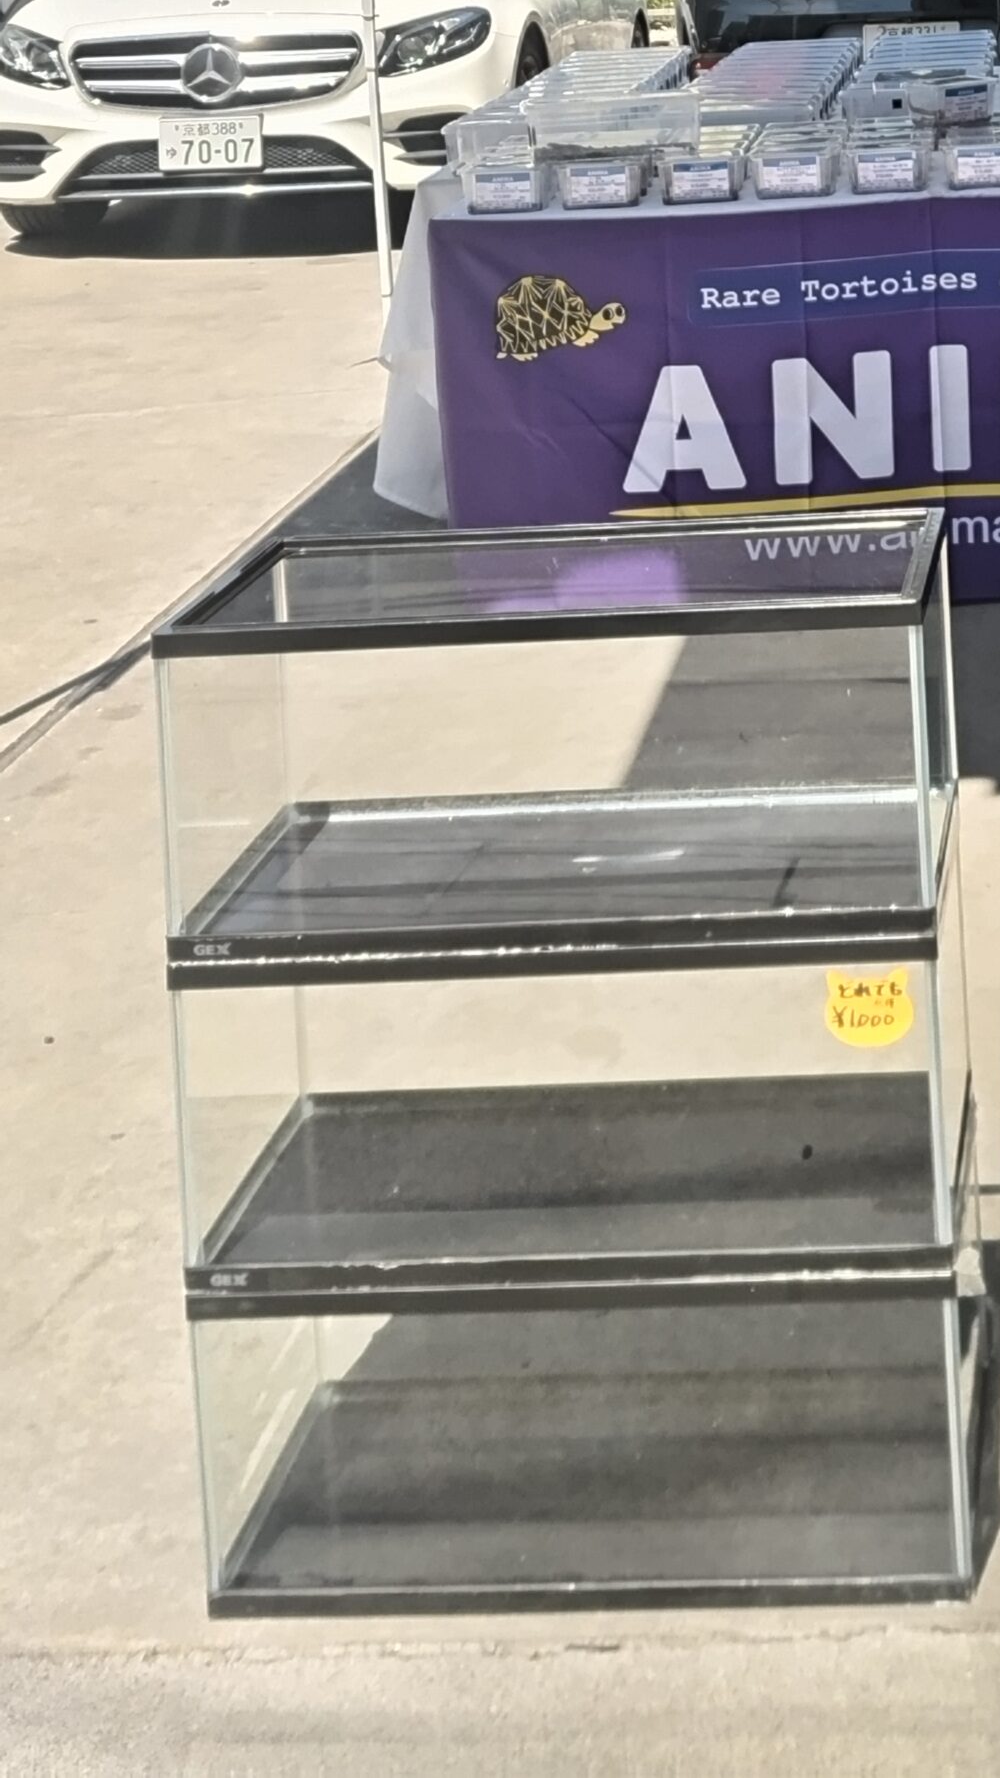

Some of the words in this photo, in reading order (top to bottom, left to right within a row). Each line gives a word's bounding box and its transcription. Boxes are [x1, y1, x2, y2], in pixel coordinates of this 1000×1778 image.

[181, 137, 255, 165] 70-07
[700, 286, 781, 309] Rare
[801, 269, 978, 302] Tortoises
[192, 941, 232, 956] GEX
[209, 1272, 249, 1287] GEX
